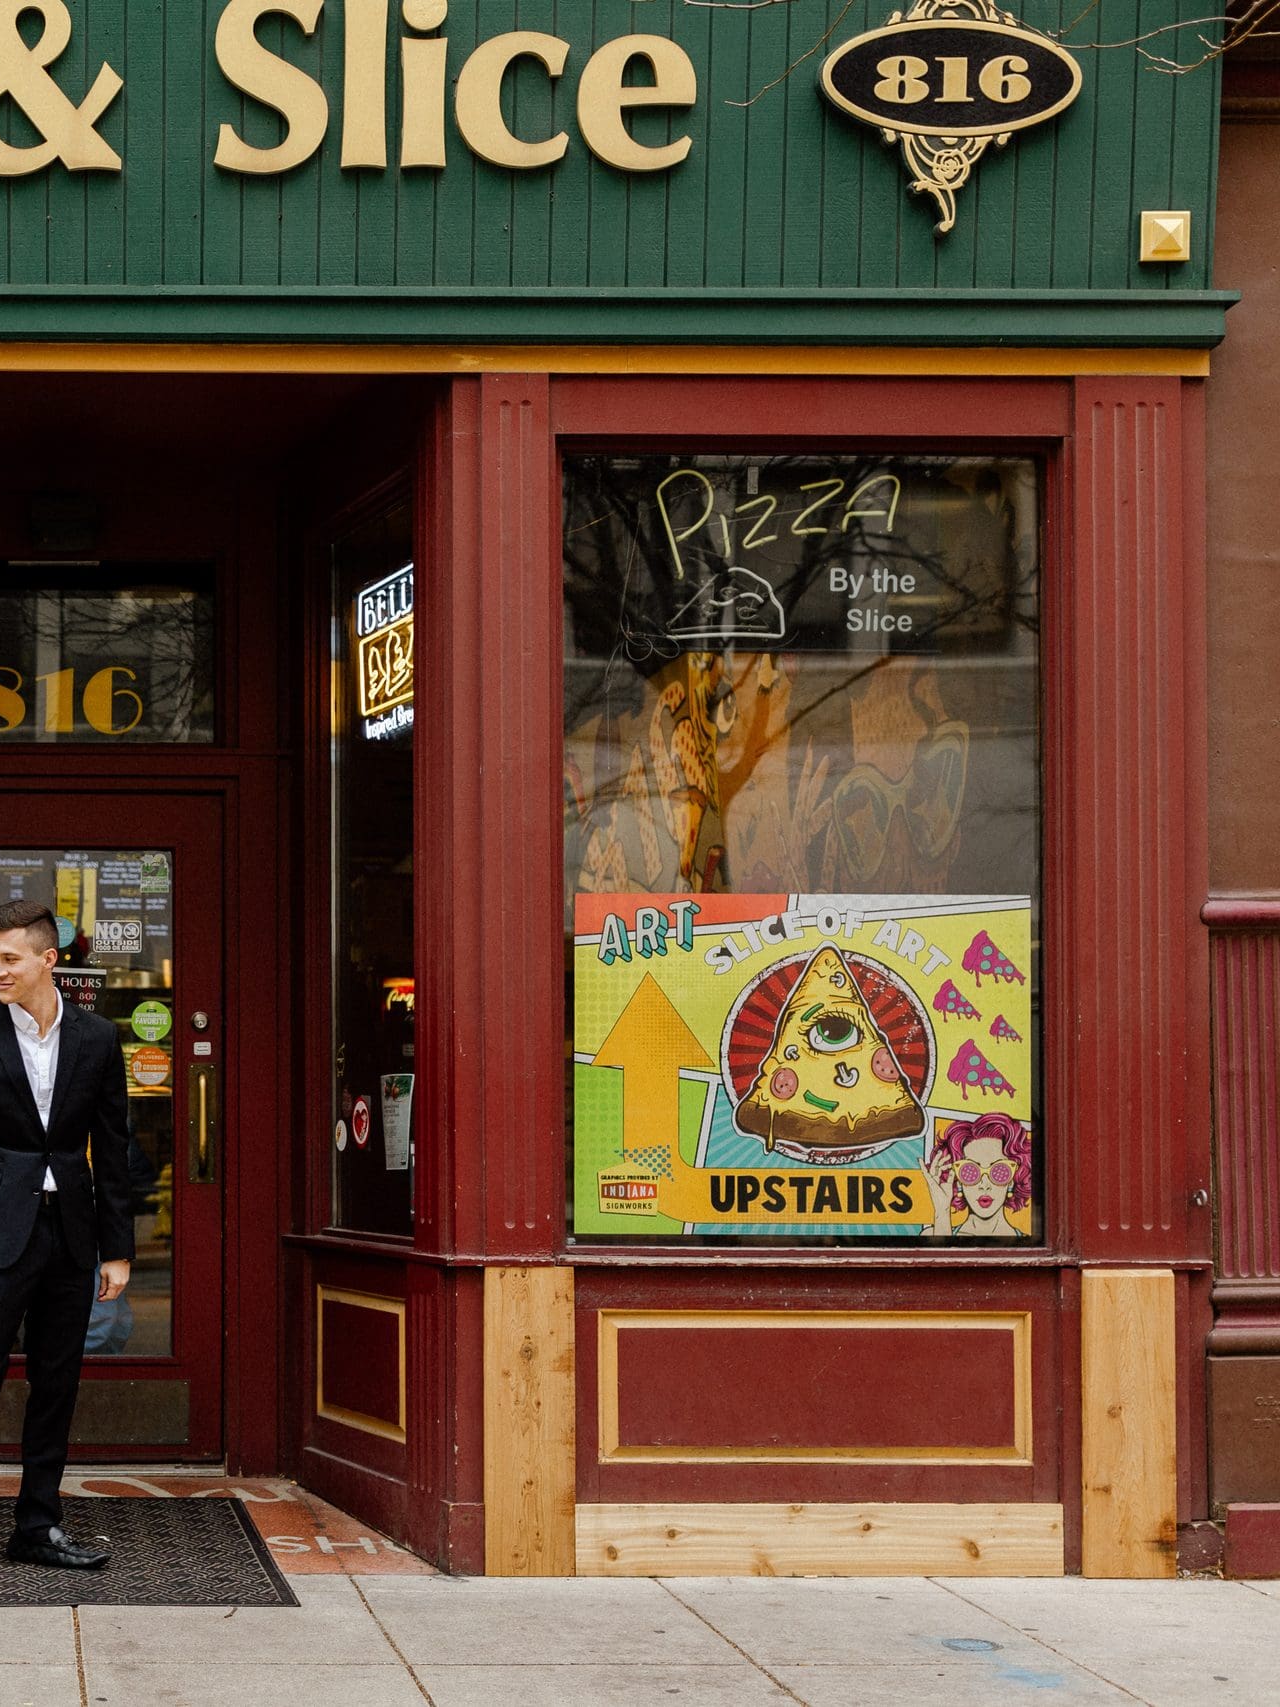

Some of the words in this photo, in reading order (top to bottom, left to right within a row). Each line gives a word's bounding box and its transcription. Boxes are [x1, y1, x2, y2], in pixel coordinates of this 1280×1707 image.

[214, 0, 697, 174] Slice
[873, 55, 1031, 104] 816
[656, 469, 901, 579] PIZZA
[829, 568, 864, 598] By
[871, 567, 916, 593] the
[846, 608, 913, 632] Slice
[95, 922, 123, 940] NO
[598, 899, 702, 966] ART
[703, 909, 806, 976] SLICE
[814, 906, 866, 940] OF
[873, 919, 952, 977] ART
[61, 977, 101, 988] HOURS
[604, 1184, 654, 1198] INDIANA
[710, 1174, 914, 1214] UPSTAIRS
[266, 1535, 413, 1554] SH
